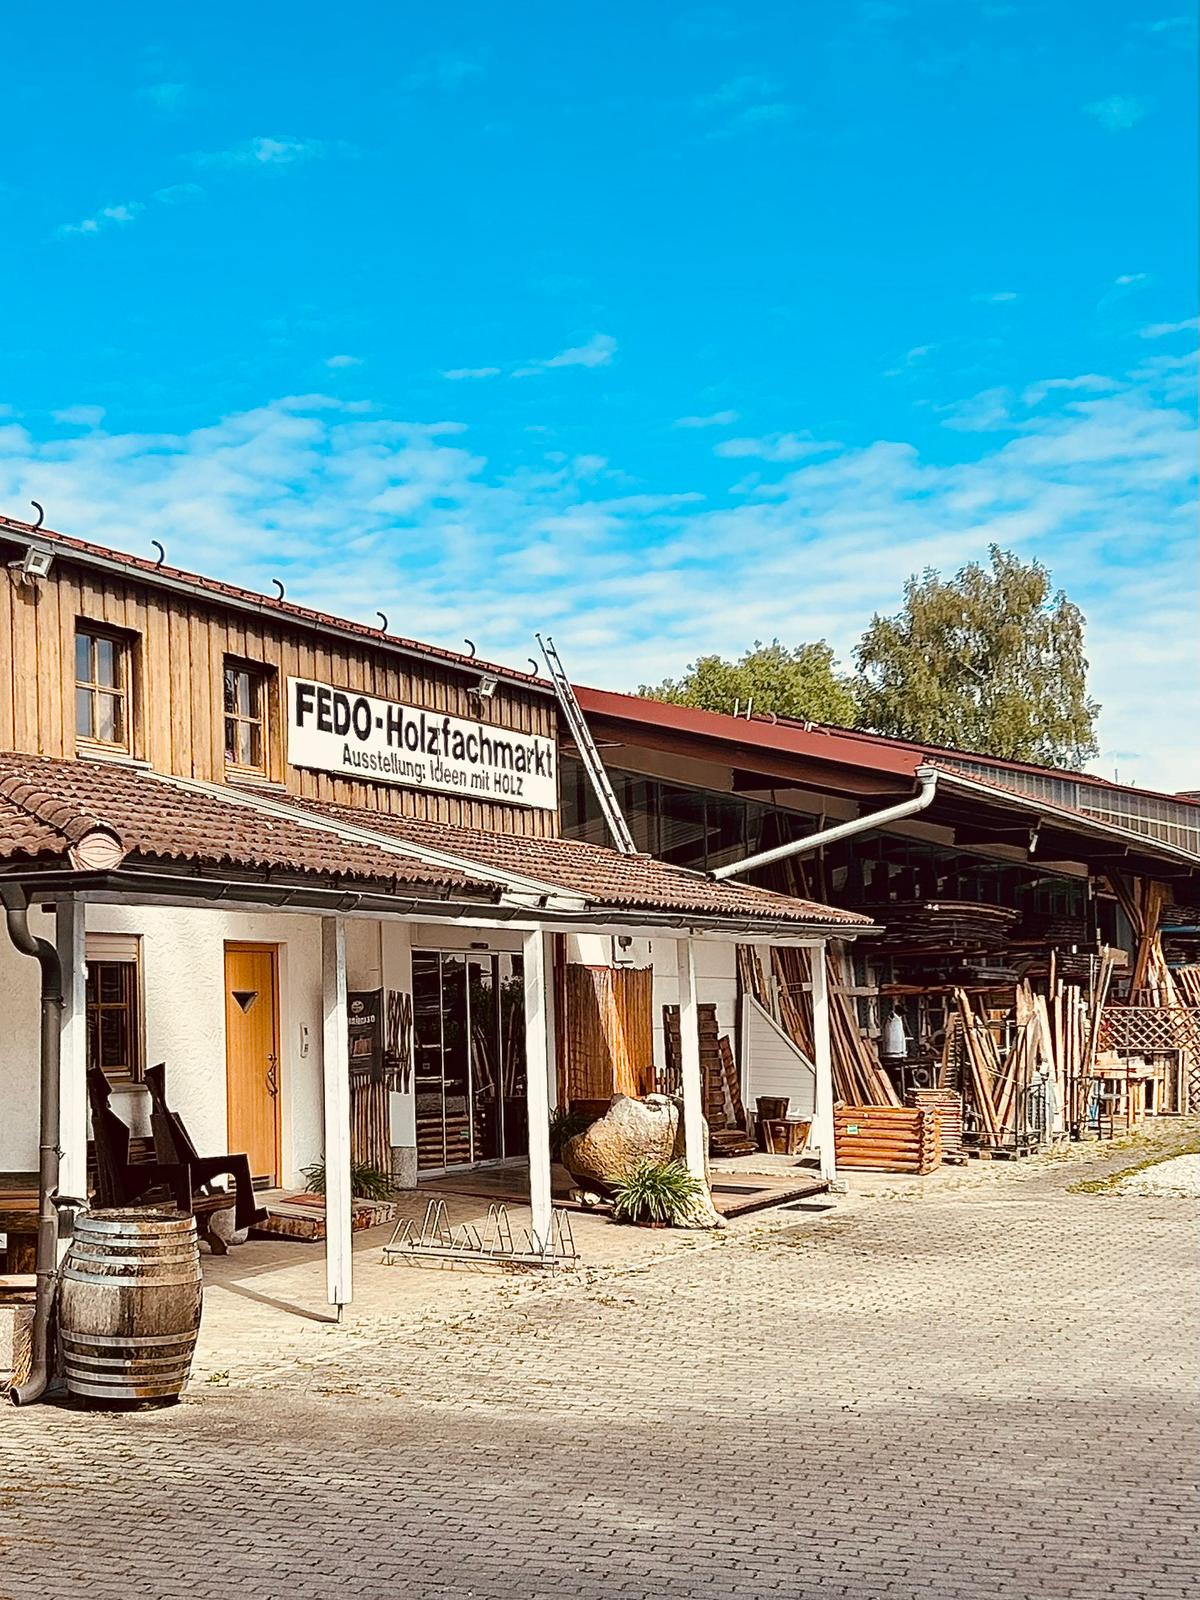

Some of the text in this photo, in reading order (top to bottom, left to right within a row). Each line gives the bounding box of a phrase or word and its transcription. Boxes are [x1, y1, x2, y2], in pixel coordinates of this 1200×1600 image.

[343, 743, 524, 797] Ausstellung: Ideen mit HOLZ
